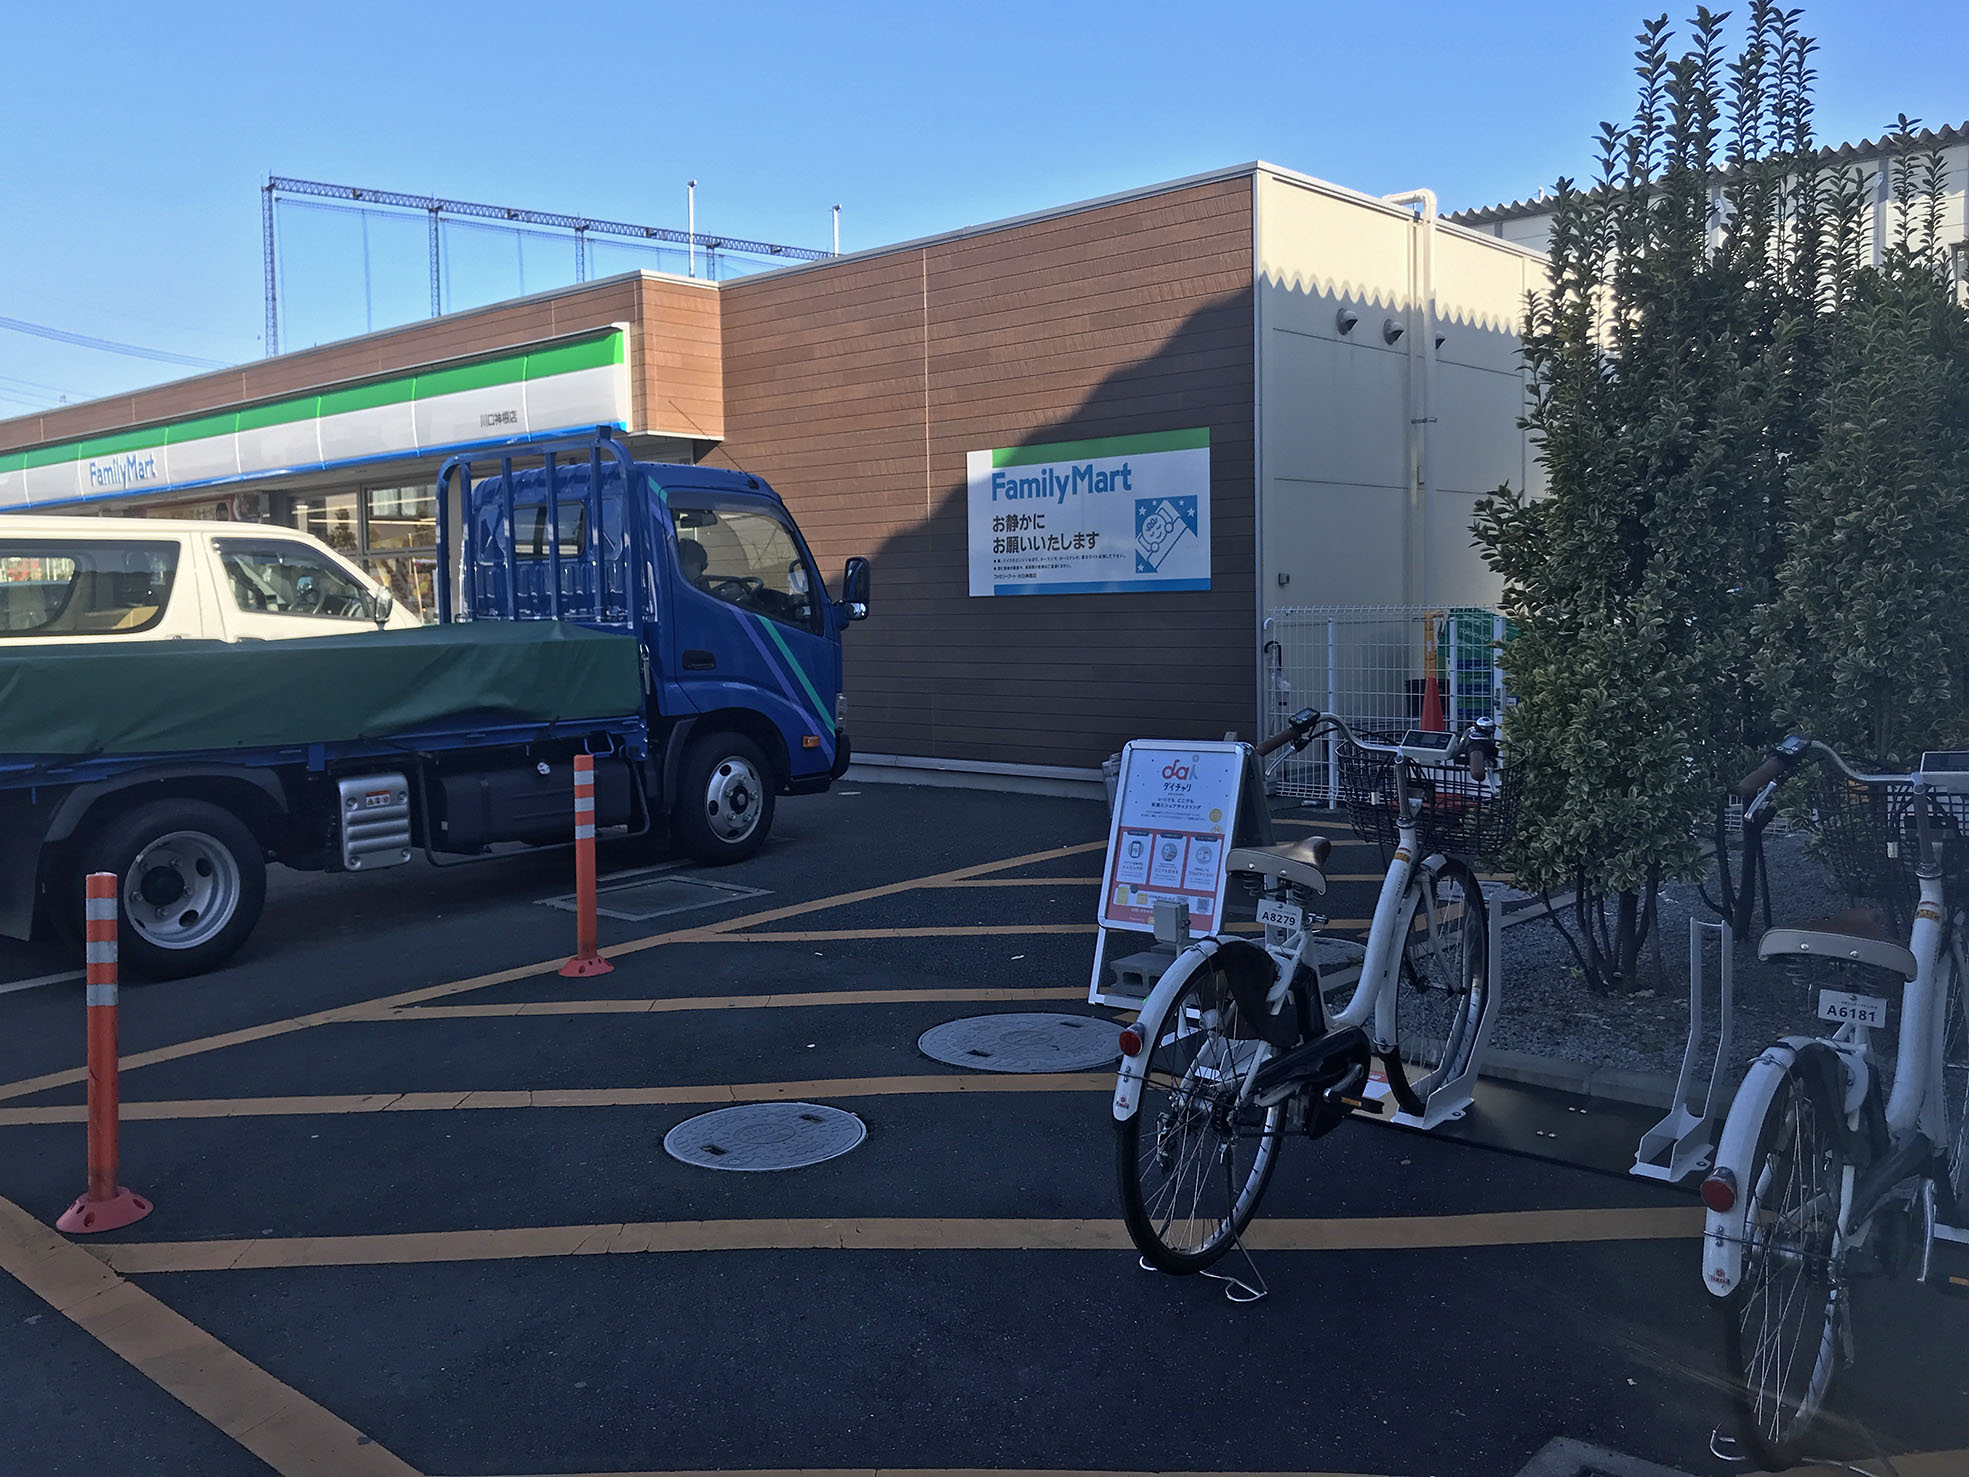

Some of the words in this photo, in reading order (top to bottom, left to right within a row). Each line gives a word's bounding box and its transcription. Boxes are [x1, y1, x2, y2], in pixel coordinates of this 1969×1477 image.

[89, 453, 156, 489] FamilyMart
[992, 462, 1132, 504] FamilyMart
[992, 513, 1046, 533] お静かに
[992, 531, 1100, 554] お願いいたします
[1163, 782, 1192, 793] ダイチャリ
[1261, 911, 1296, 926] A8279
[1826, 1004, 1876, 1022] A6181
